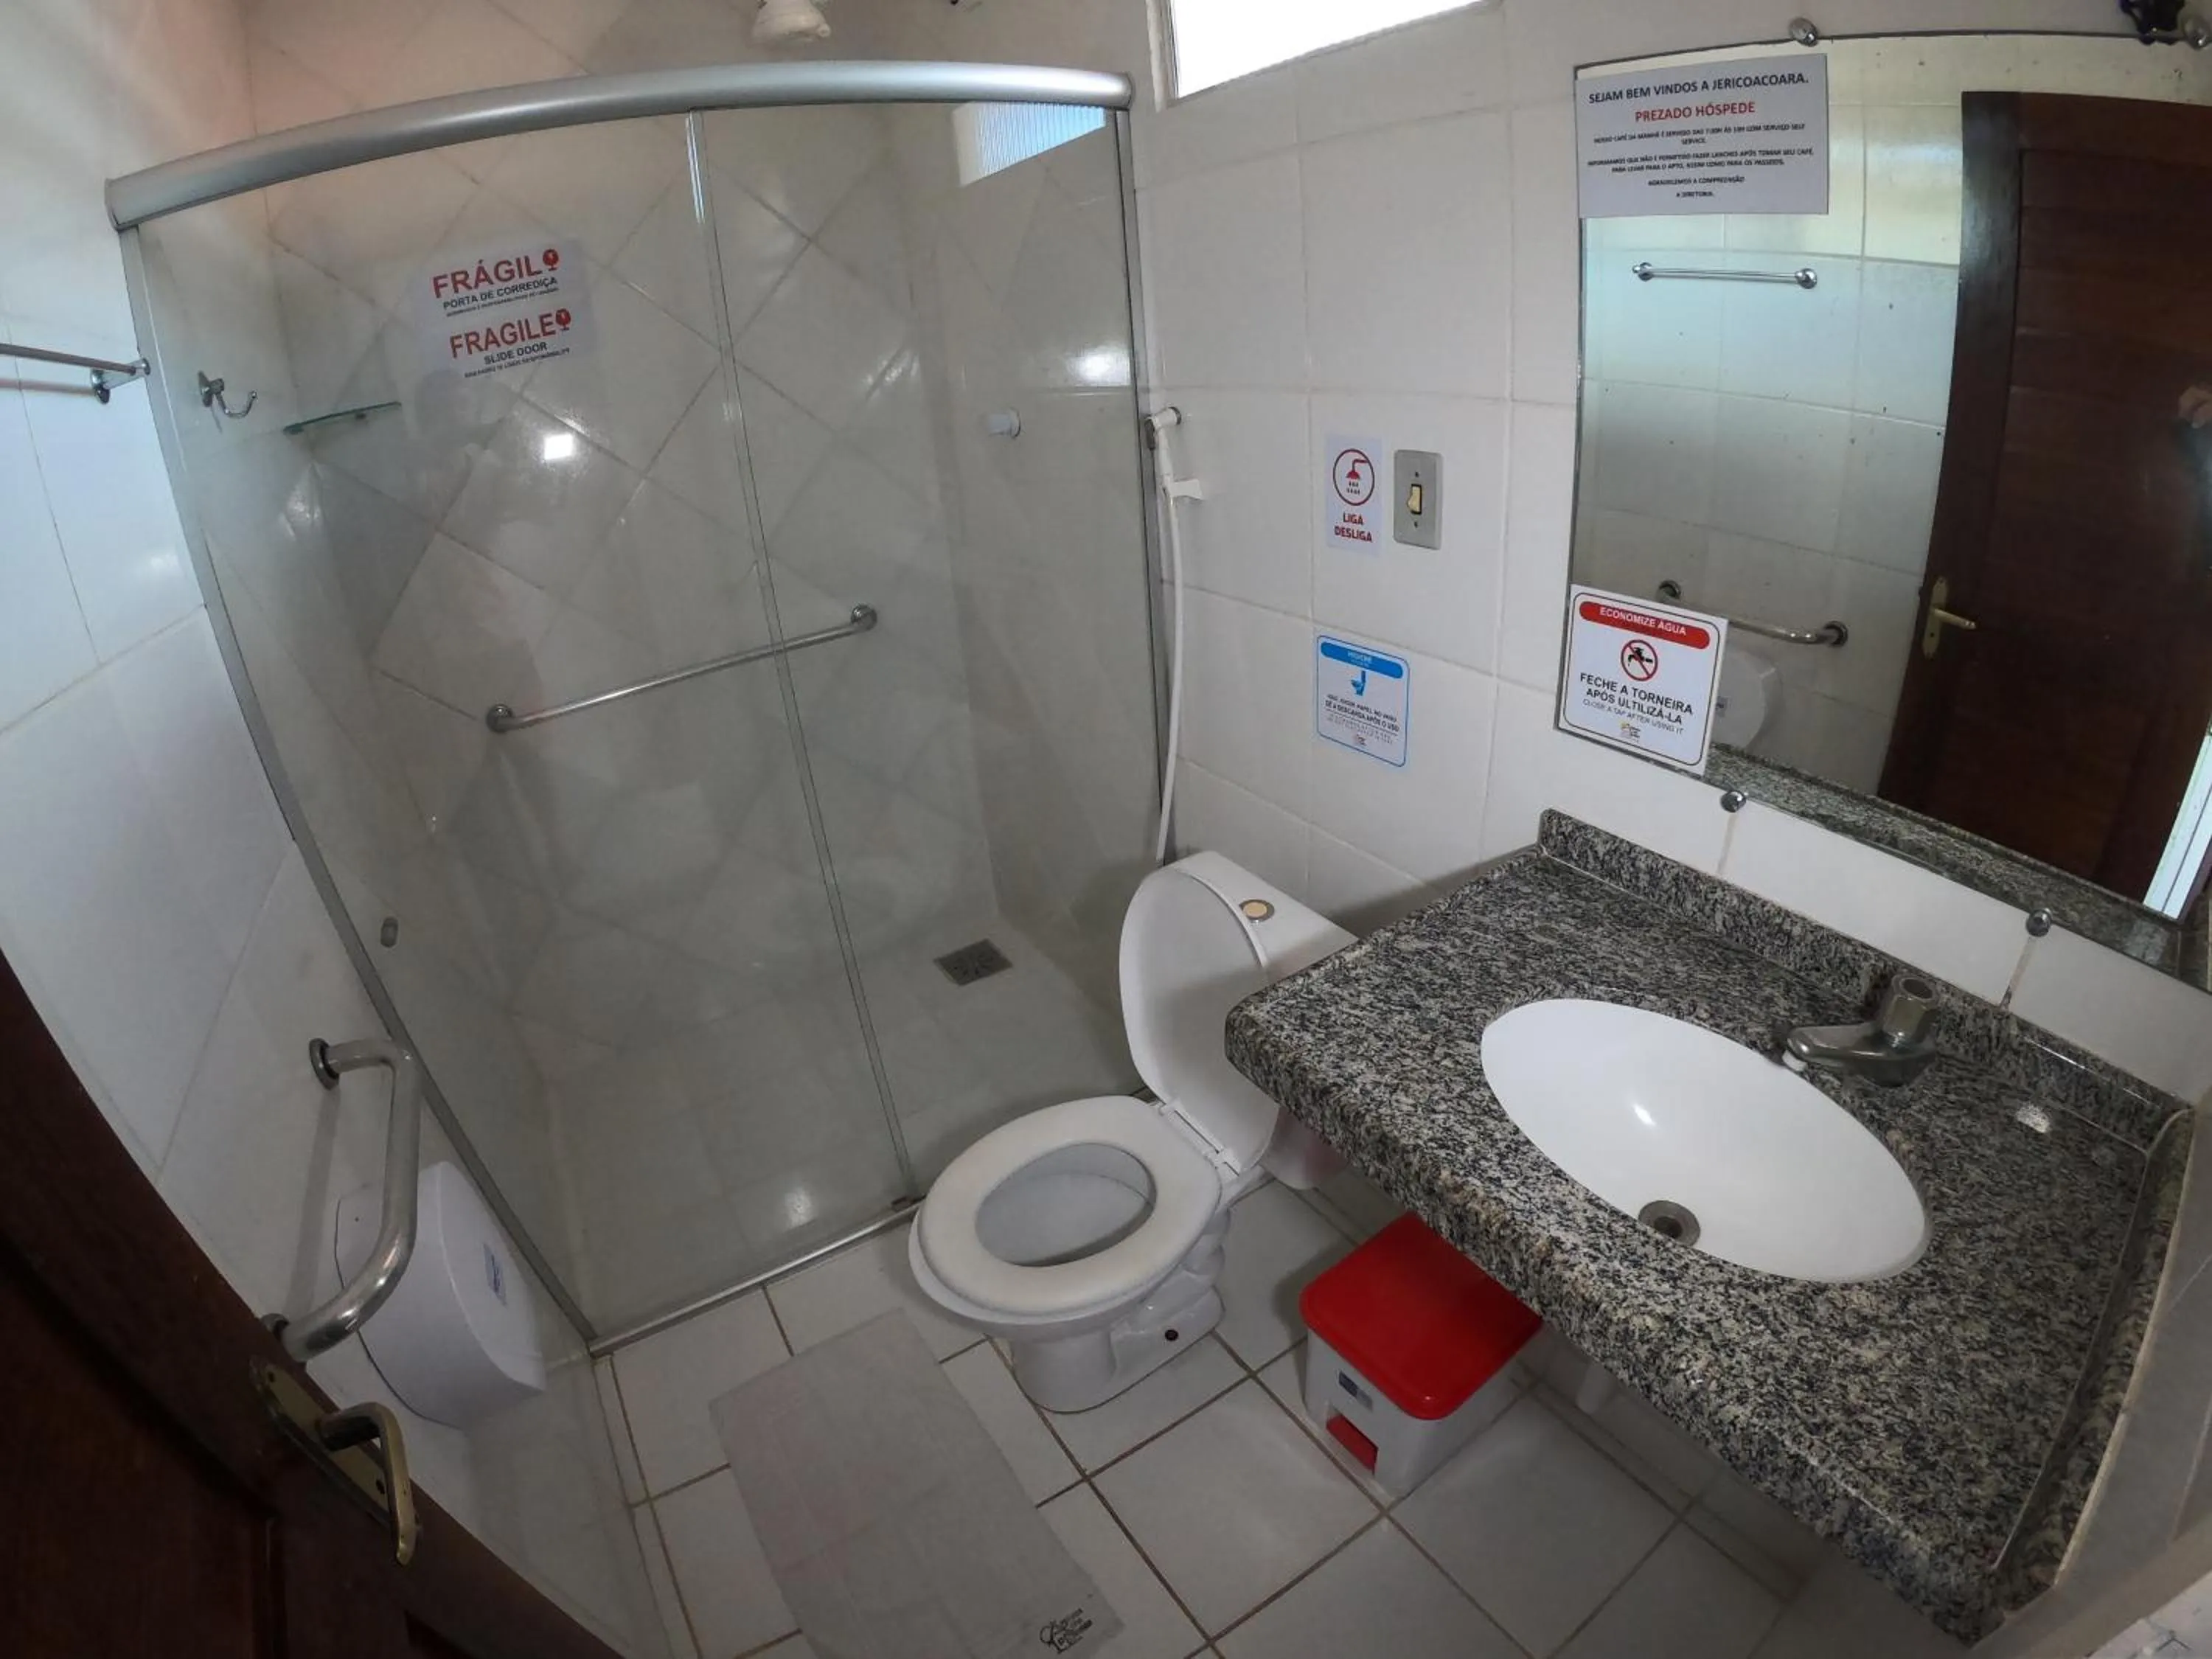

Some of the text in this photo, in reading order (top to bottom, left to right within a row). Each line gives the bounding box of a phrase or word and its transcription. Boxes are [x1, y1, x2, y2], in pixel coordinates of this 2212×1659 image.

[1589, 73, 1808, 104] SEJAM BEM VINDOS A JERICOACOARA.
[1635, 102, 1756, 122] PREZADO HÓSPEDE
[433, 255, 543, 299] FRÁGIL
[443, 294, 478, 310] PORTA
[481, 291, 494, 302] DE
[496, 276, 558, 296] CORREDIÇA
[449, 313, 557, 359] FRAGILE
[484, 350, 515, 365] SLIDE
[517, 341, 548, 356] DOOR
[1343, 512, 1364, 526] LIGA
[1334, 525, 1373, 543] DESLIGA
[1599, 606, 1656, 628] ECONOMIZE
[1580, 672, 1693, 714] FECHE A TORNEIRA
[1586, 687, 1615, 704] APÓS
[1627, 712, 1650, 723] AFTER
